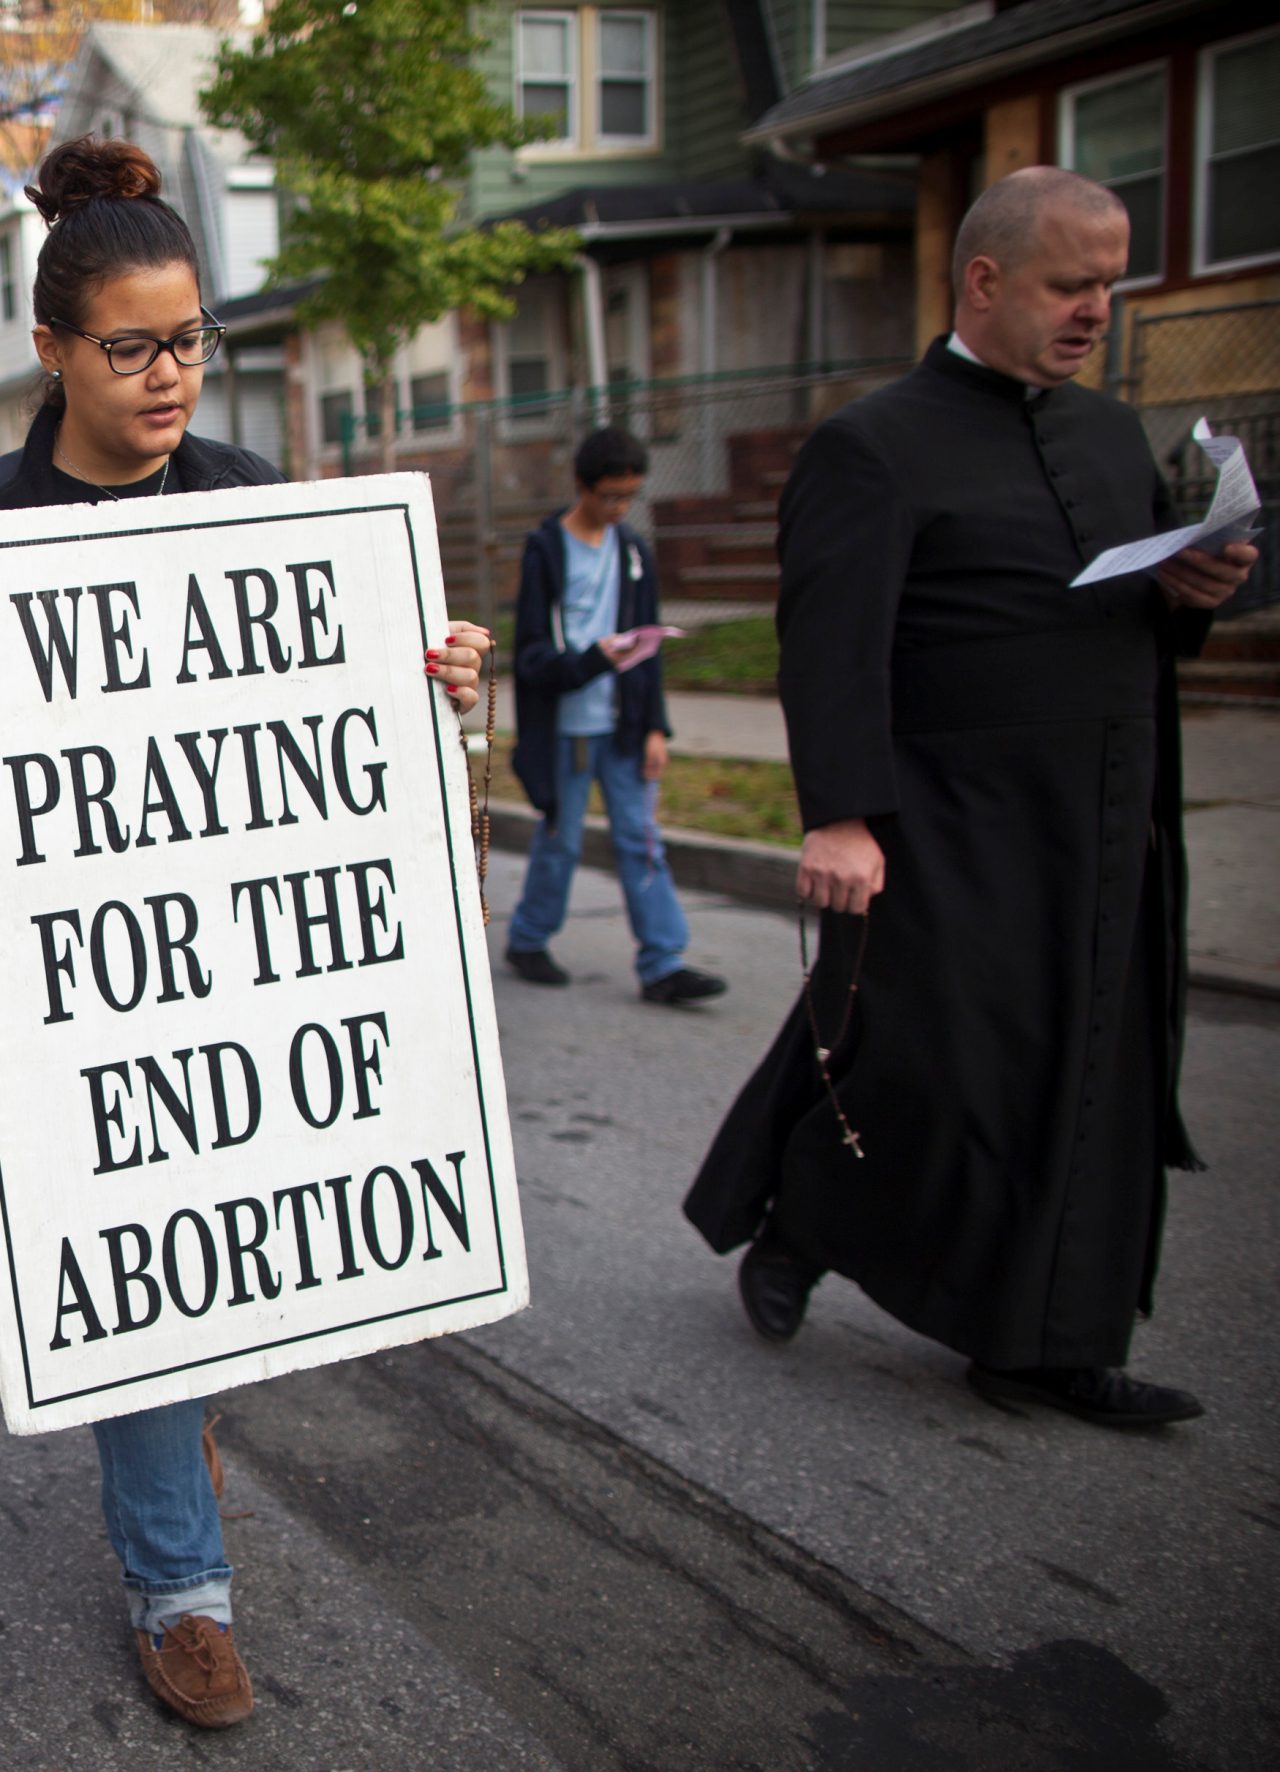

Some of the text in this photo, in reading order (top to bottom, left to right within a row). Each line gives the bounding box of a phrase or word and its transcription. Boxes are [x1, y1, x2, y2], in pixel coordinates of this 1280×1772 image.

[9, 561, 345, 703] WE ARE
[3, 707, 388, 867] PRAYING
[31, 858, 405, 1025] FOR THE
[80, 1012, 390, 1176] END OF
[49, 1151, 472, 1352] ABORTION
